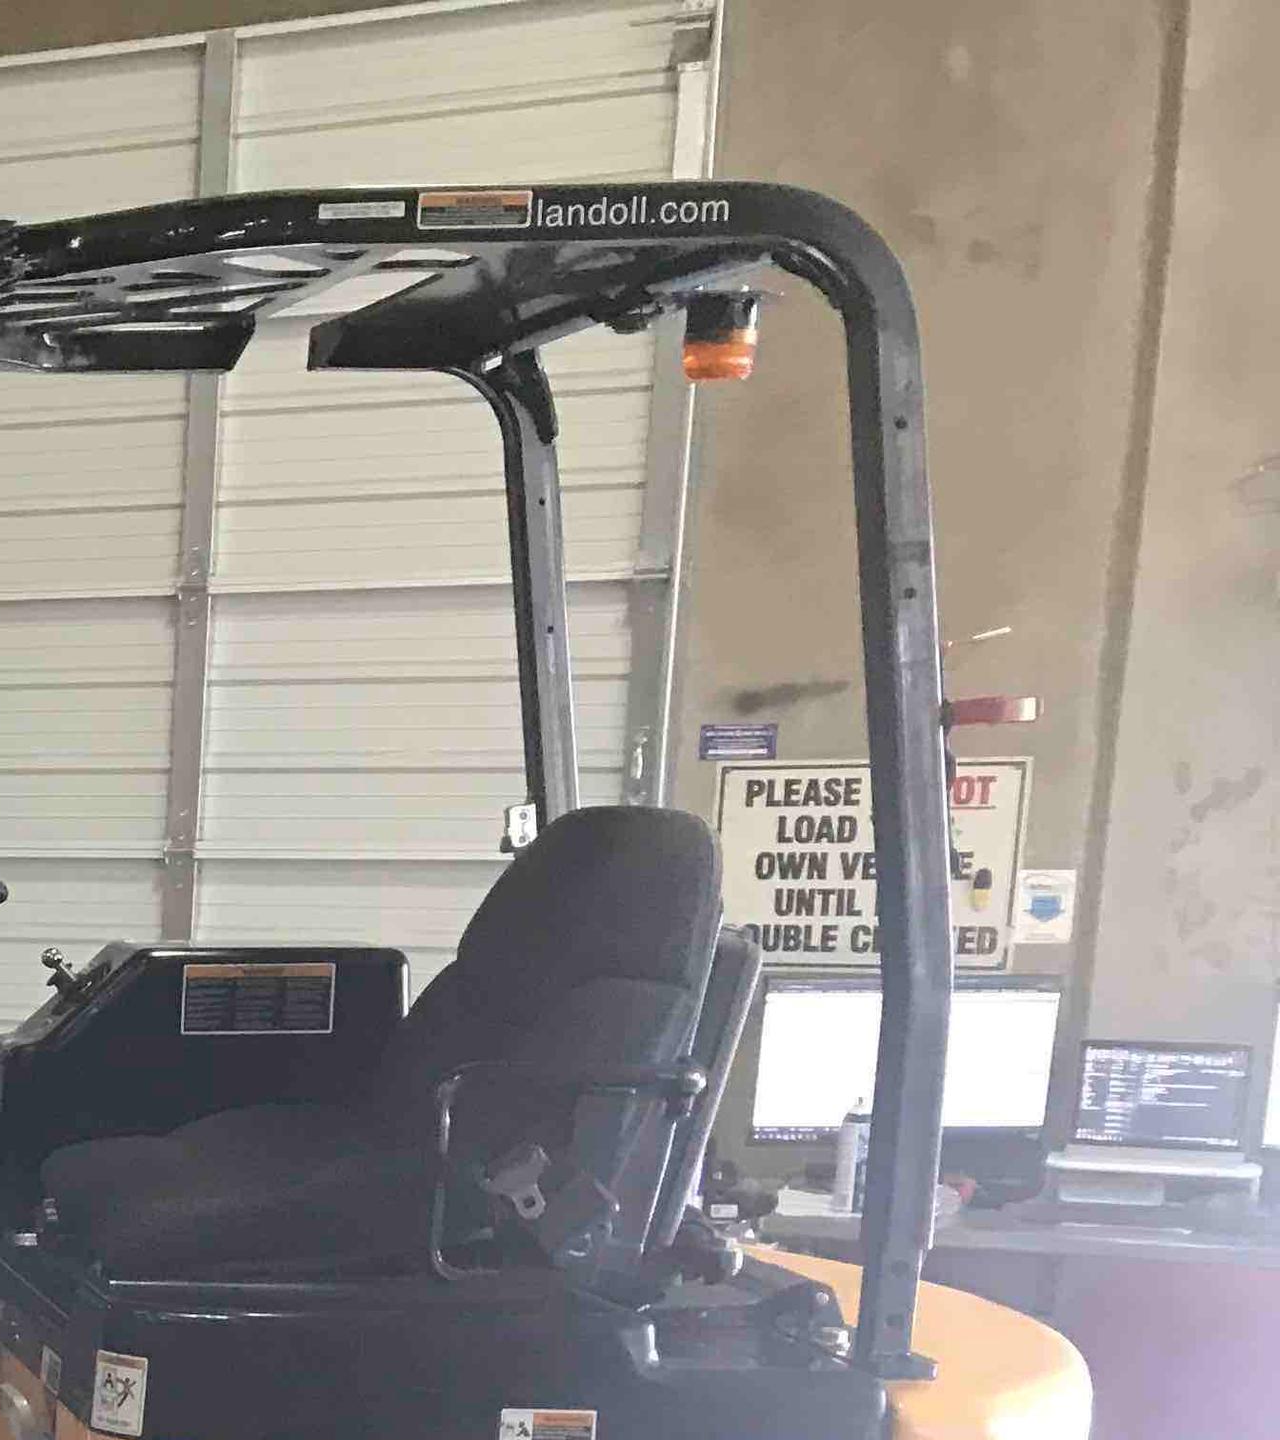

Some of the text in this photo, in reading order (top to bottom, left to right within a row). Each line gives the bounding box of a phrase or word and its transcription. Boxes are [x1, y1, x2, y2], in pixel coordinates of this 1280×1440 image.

[536, 195, 730, 228] landoll.com
[744, 775, 998, 808] PLEASE OT
[776, 814, 859, 845] LOAD
[754, 850, 828, 881] OWN
[773, 887, 863, 917] UNTIL
